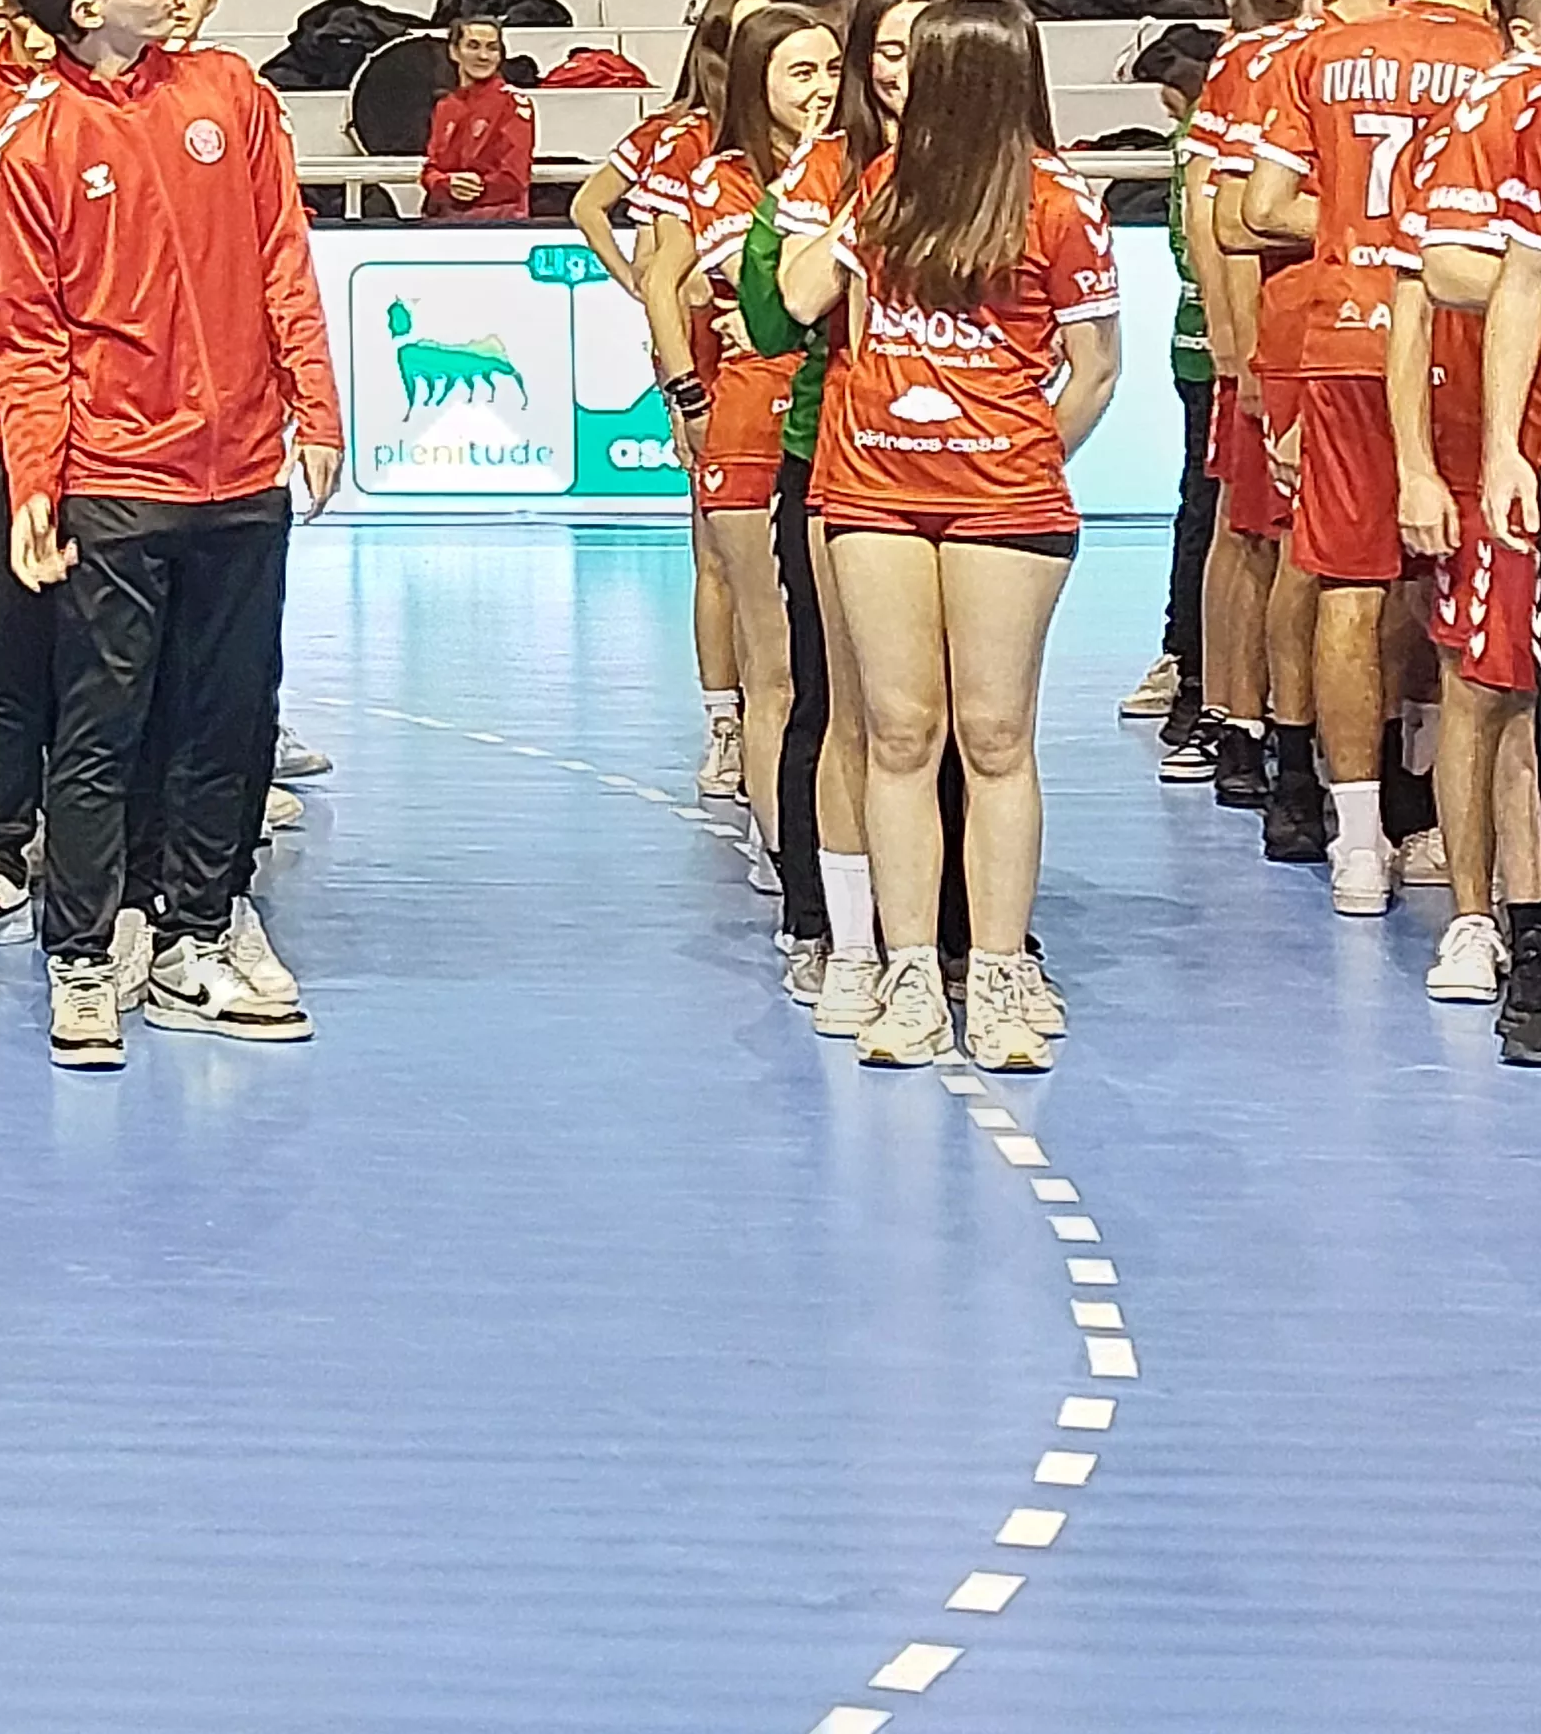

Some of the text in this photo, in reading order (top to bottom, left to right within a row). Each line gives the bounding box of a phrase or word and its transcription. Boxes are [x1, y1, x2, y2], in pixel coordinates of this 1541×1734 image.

[1322, 47, 1400, 105] IVÁN
[1351, 112, 1415, 218] 7
[374, 436, 554, 470] plenitude
